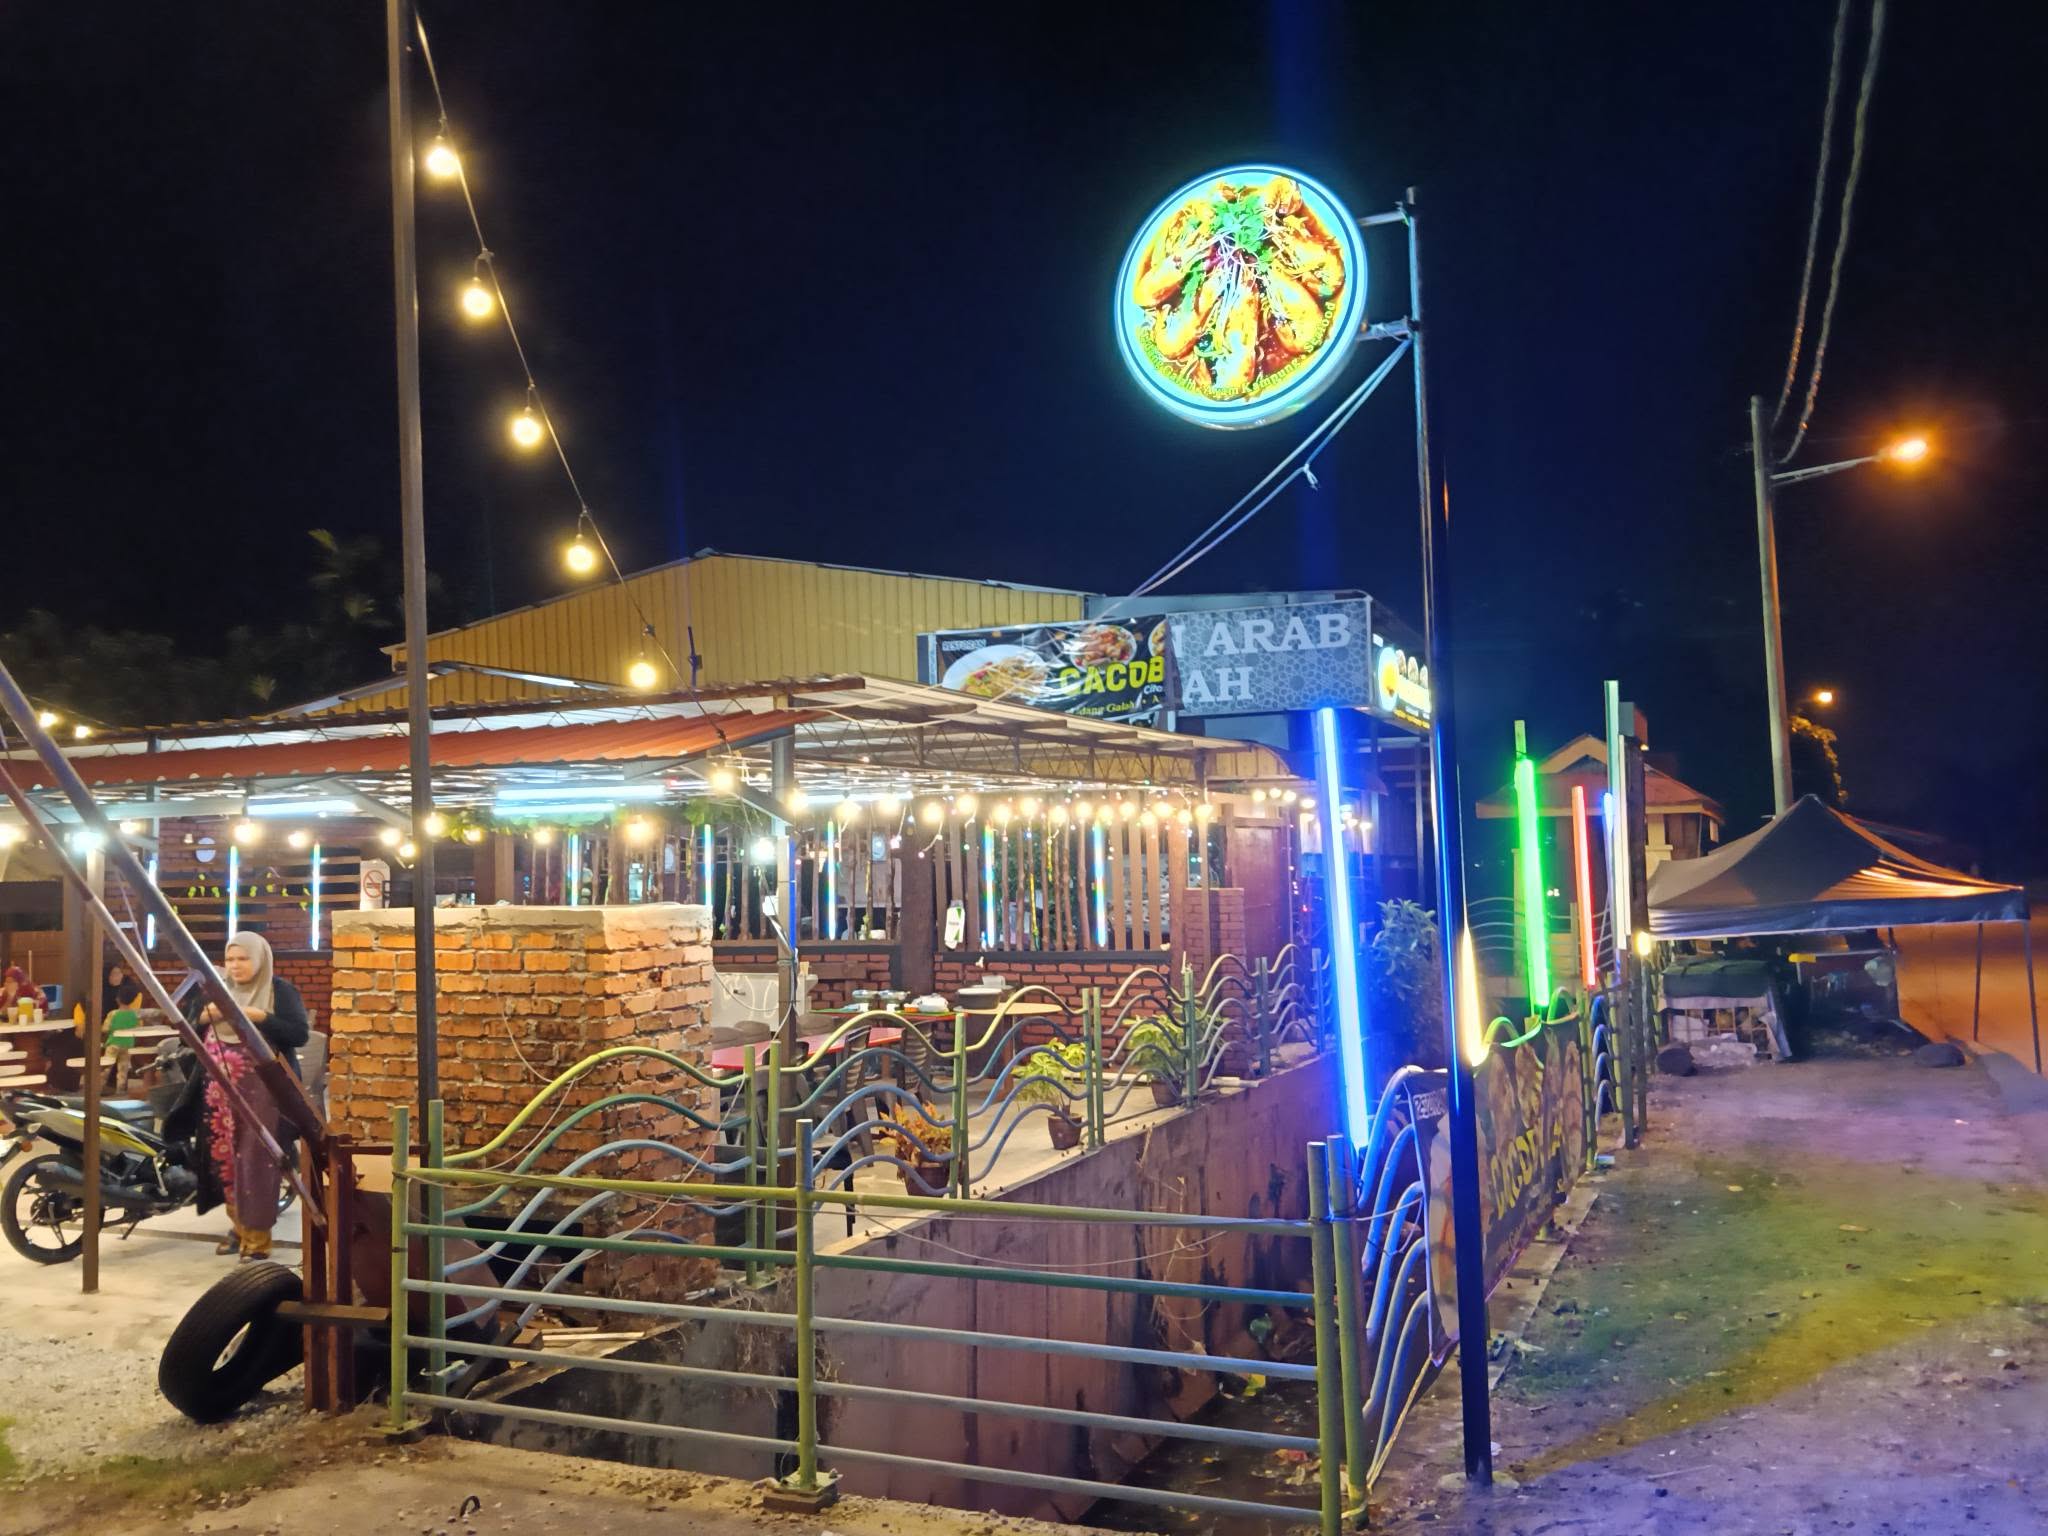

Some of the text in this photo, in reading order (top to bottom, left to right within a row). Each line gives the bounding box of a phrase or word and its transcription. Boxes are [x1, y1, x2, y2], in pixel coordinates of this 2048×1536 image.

[1242, 357, 1300, 394] Kampung
[1304, 301, 1335, 354] Seafood
[1203, 613, 1350, 656] ARAB
[1183, 666, 1254, 702] AH
